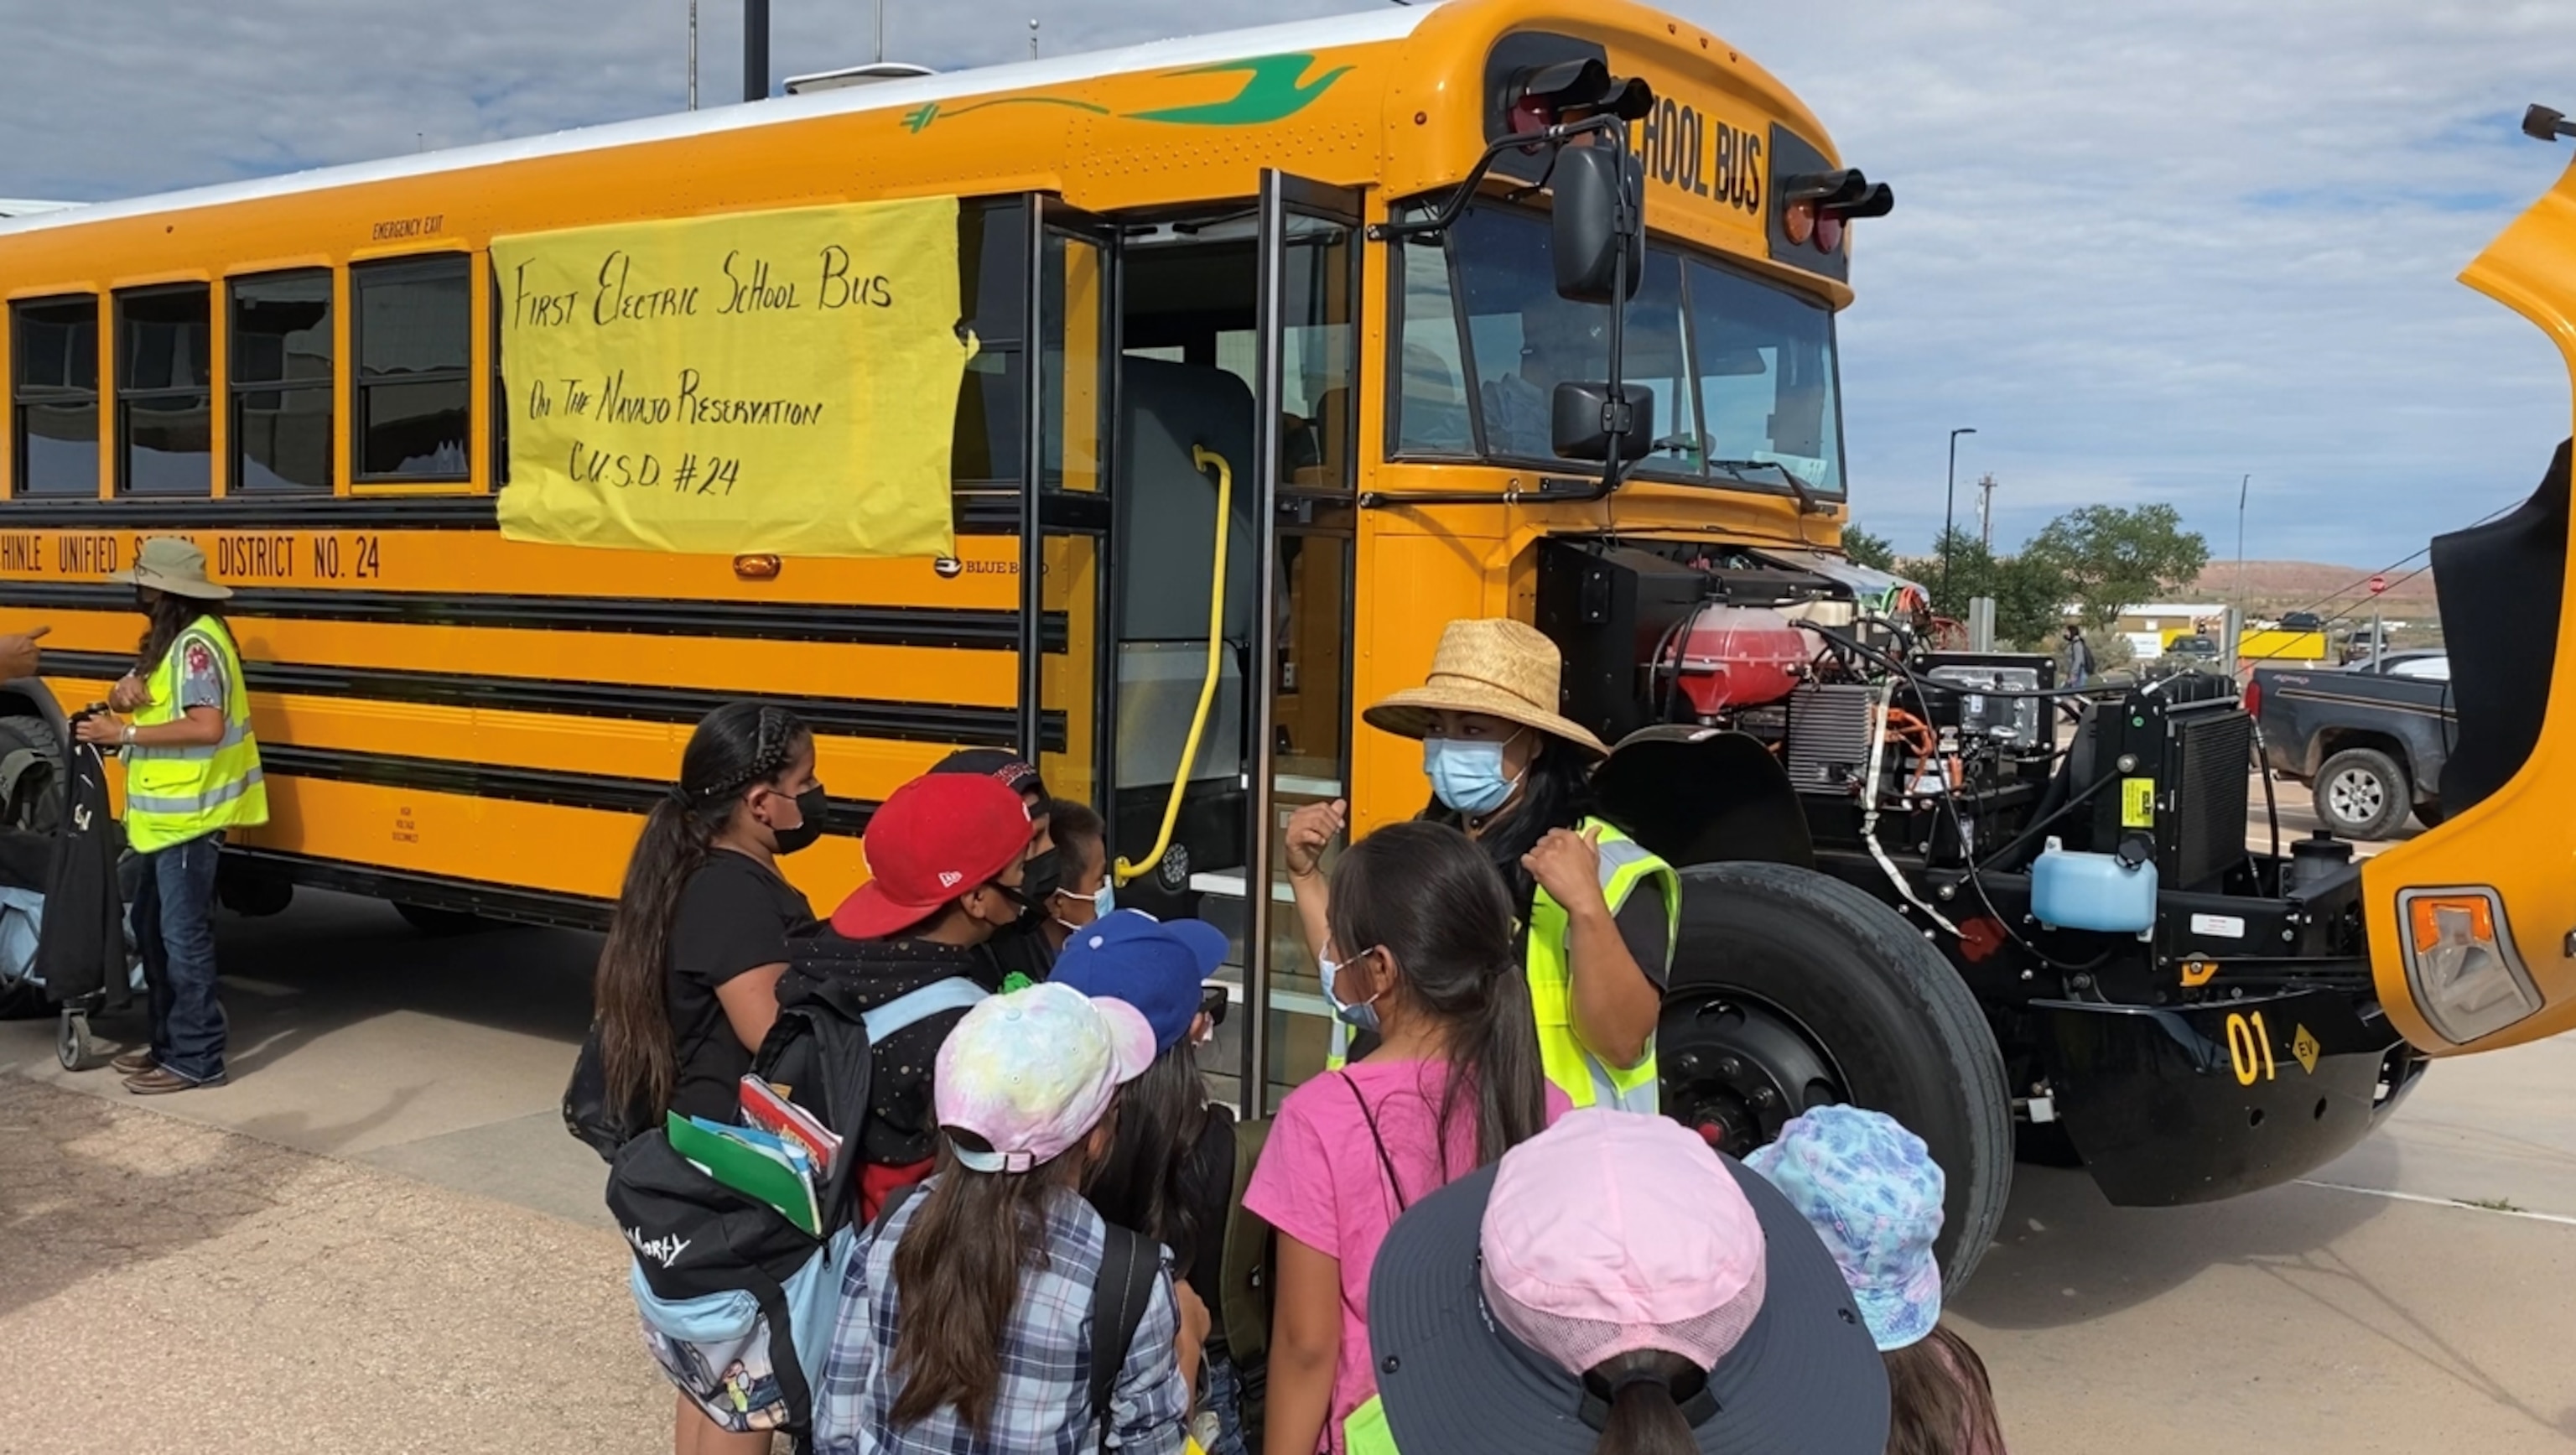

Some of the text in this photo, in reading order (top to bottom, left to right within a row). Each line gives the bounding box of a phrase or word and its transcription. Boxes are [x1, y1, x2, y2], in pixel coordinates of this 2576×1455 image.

[1626, 95, 1761, 216] HOOL BUS
[372, 214, 444, 241] EMERGENCY EXIT
[676, 367, 823, 426] RESERVATION
[673, 453, 740, 496] #24
[2, 535, 42, 571] HINLE
[59, 536, 117, 574] UNIFIED
[218, 535, 295, 577] DISTRICT
[314, 536, 345, 579] NO.
[356, 536, 379, 578] 24
[966, 560, 1050, 576] BLUE BD
[2226, 1010, 2275, 1085] 01
[2298, 1039, 2313, 1057] EV
